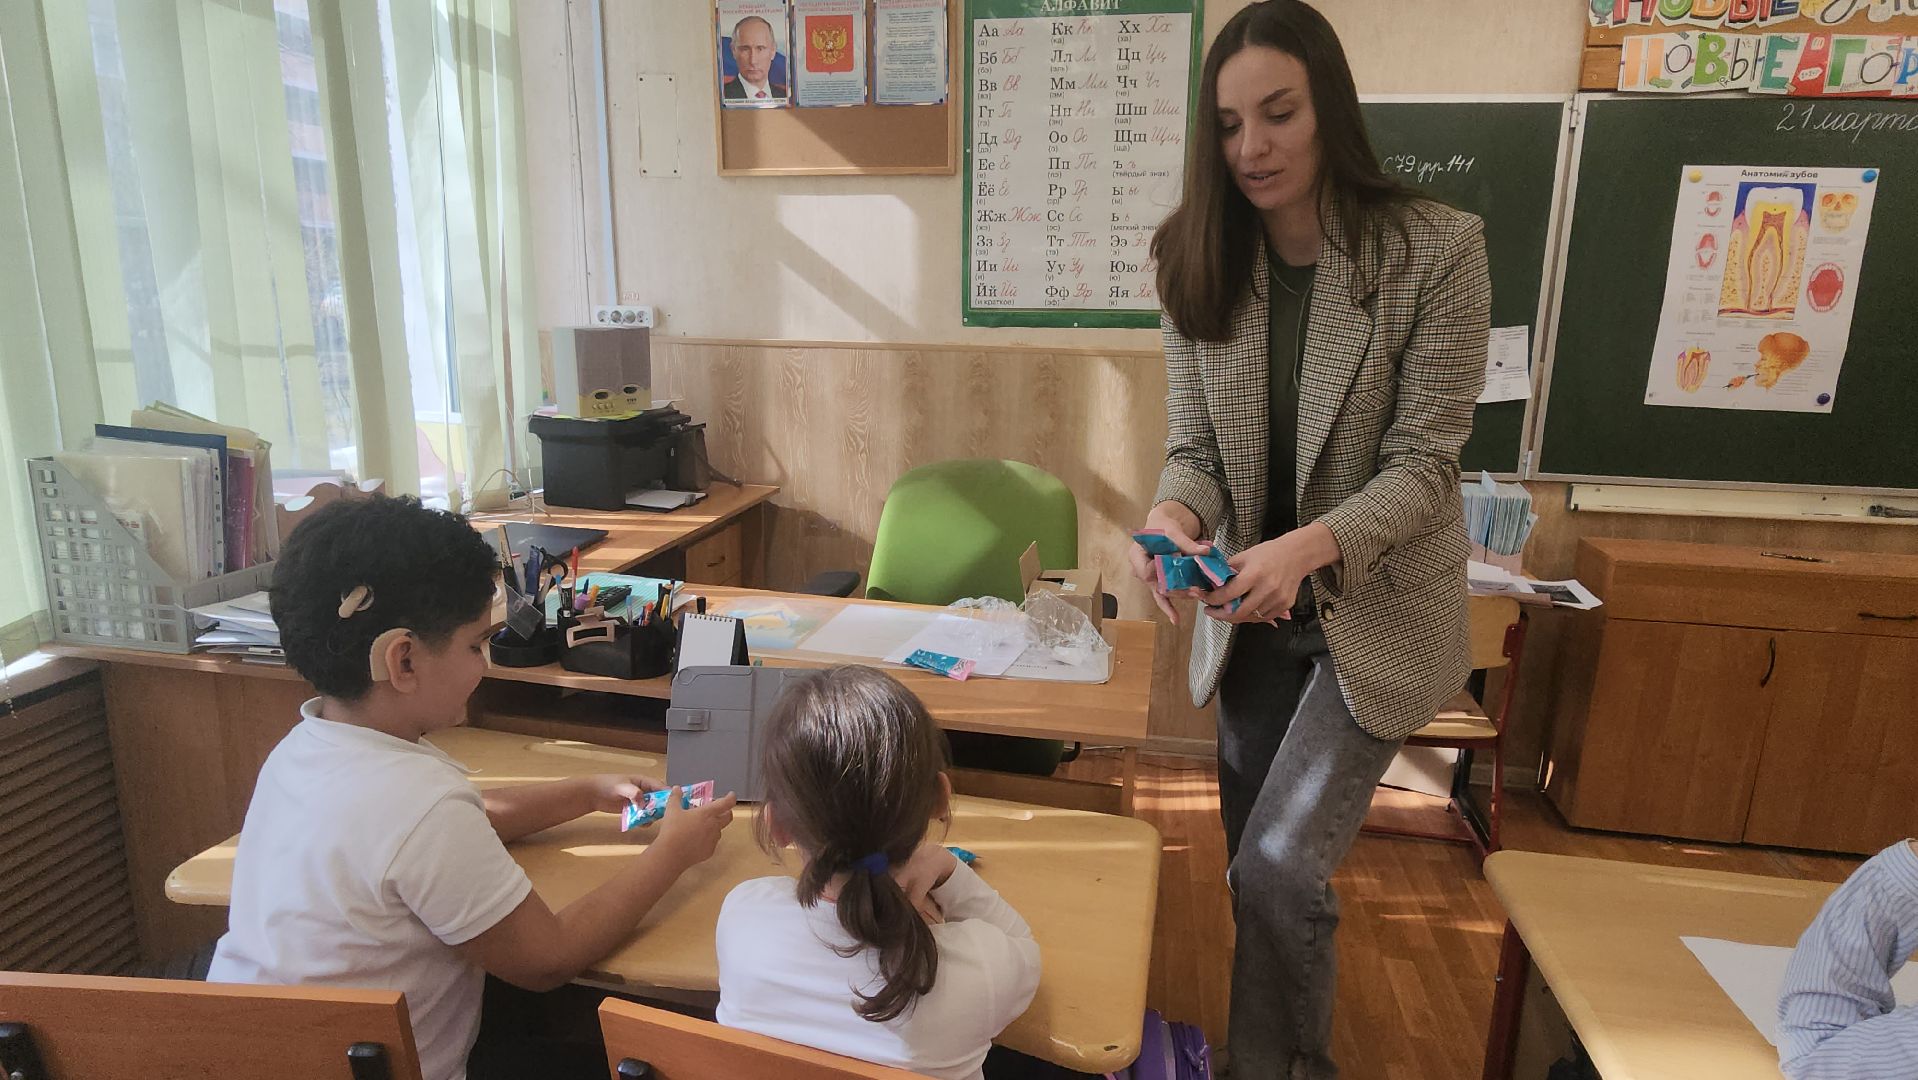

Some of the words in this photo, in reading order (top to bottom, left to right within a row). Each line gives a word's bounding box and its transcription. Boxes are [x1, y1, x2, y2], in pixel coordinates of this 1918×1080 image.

[979, 24, 999, 37] Аа
[1052, 23, 1073, 35] Кк
[1118, 21, 1140, 33] Хх
[979, 52, 997, 64] Бб
[1051, 50, 1072, 62] Лл
[1117, 48, 1140, 63] Цц
[979, 79, 997, 91] Вв
[1050, 77, 1075, 89] Мм
[1117, 76, 1137, 88] Чч
[979, 106, 994, 117] Гг
[1050, 105, 1072, 116] Нн
[1116, 103, 1147, 115] Шш
[1776, 103, 1815, 130] 21
[978, 133, 997, 145] Дд
[1049, 131, 1067, 143] Оо
[1114, 130, 1147, 145] Щщ
[978, 159, 995, 170] Ее
[1048, 158, 1070, 169] Пп
[1447, 155, 1475, 174] 141
[1741, 169, 1787, 178] Анатомия
[1789, 170, 1818, 179] зубов
[978, 182, 994, 196] Ёё
[1048, 184, 1066, 198] Рр
[977, 210, 1007, 221] Жж
[1047, 210, 1064, 221] Сс
[977, 235, 993, 246] Зз
[1047, 235, 1064, 247] Тт
[1111, 235, 1128, 247] Ээ
[976, 260, 997, 271] Ии
[1046, 261, 1065, 275] Уу
[1110, 261, 1138, 272] Юю
[976, 283, 997, 296] Йй
[1045, 286, 1069, 300] Фф
[1109, 286, 1129, 297] Яя
